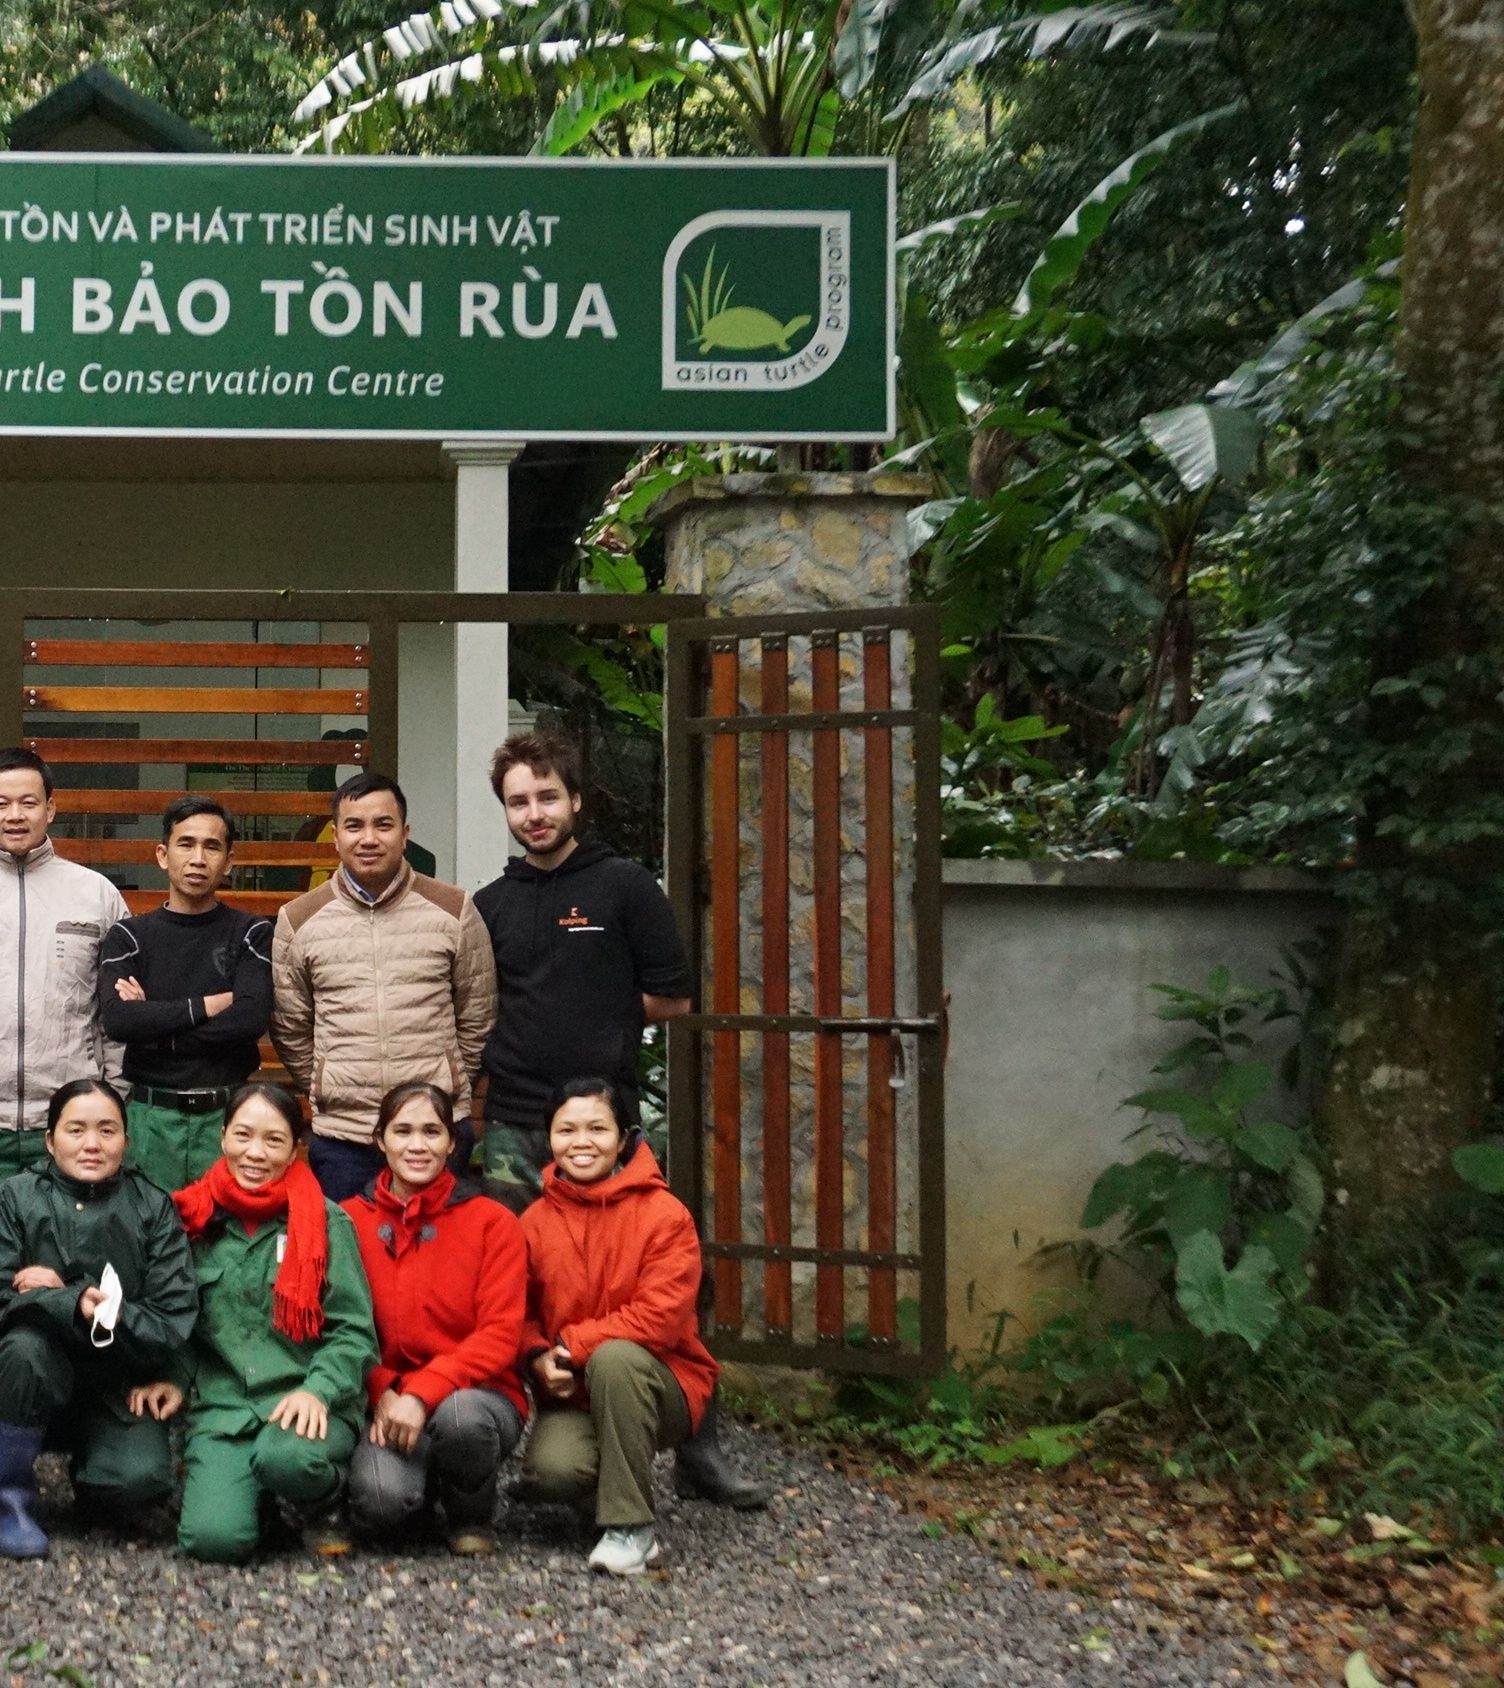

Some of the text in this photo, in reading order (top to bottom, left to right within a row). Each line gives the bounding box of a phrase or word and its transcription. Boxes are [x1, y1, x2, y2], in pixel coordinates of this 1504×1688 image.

[87, 205, 139, 243] VÀ
[150, 206, 252, 244] PHÁT
[258, 203, 373, 245] TRIỂN
[384, 214, 478, 247] SINH
[486, 209, 560, 254] VẬT
[72, 260, 231, 336] BẢO
[260, 260, 423, 337] TỒN
[459, 265, 618, 339] RÙA
[676, 227, 848, 384] asian turtle program
[79, 362, 314, 395] Conservation
[327, 365, 444, 397] Centre
